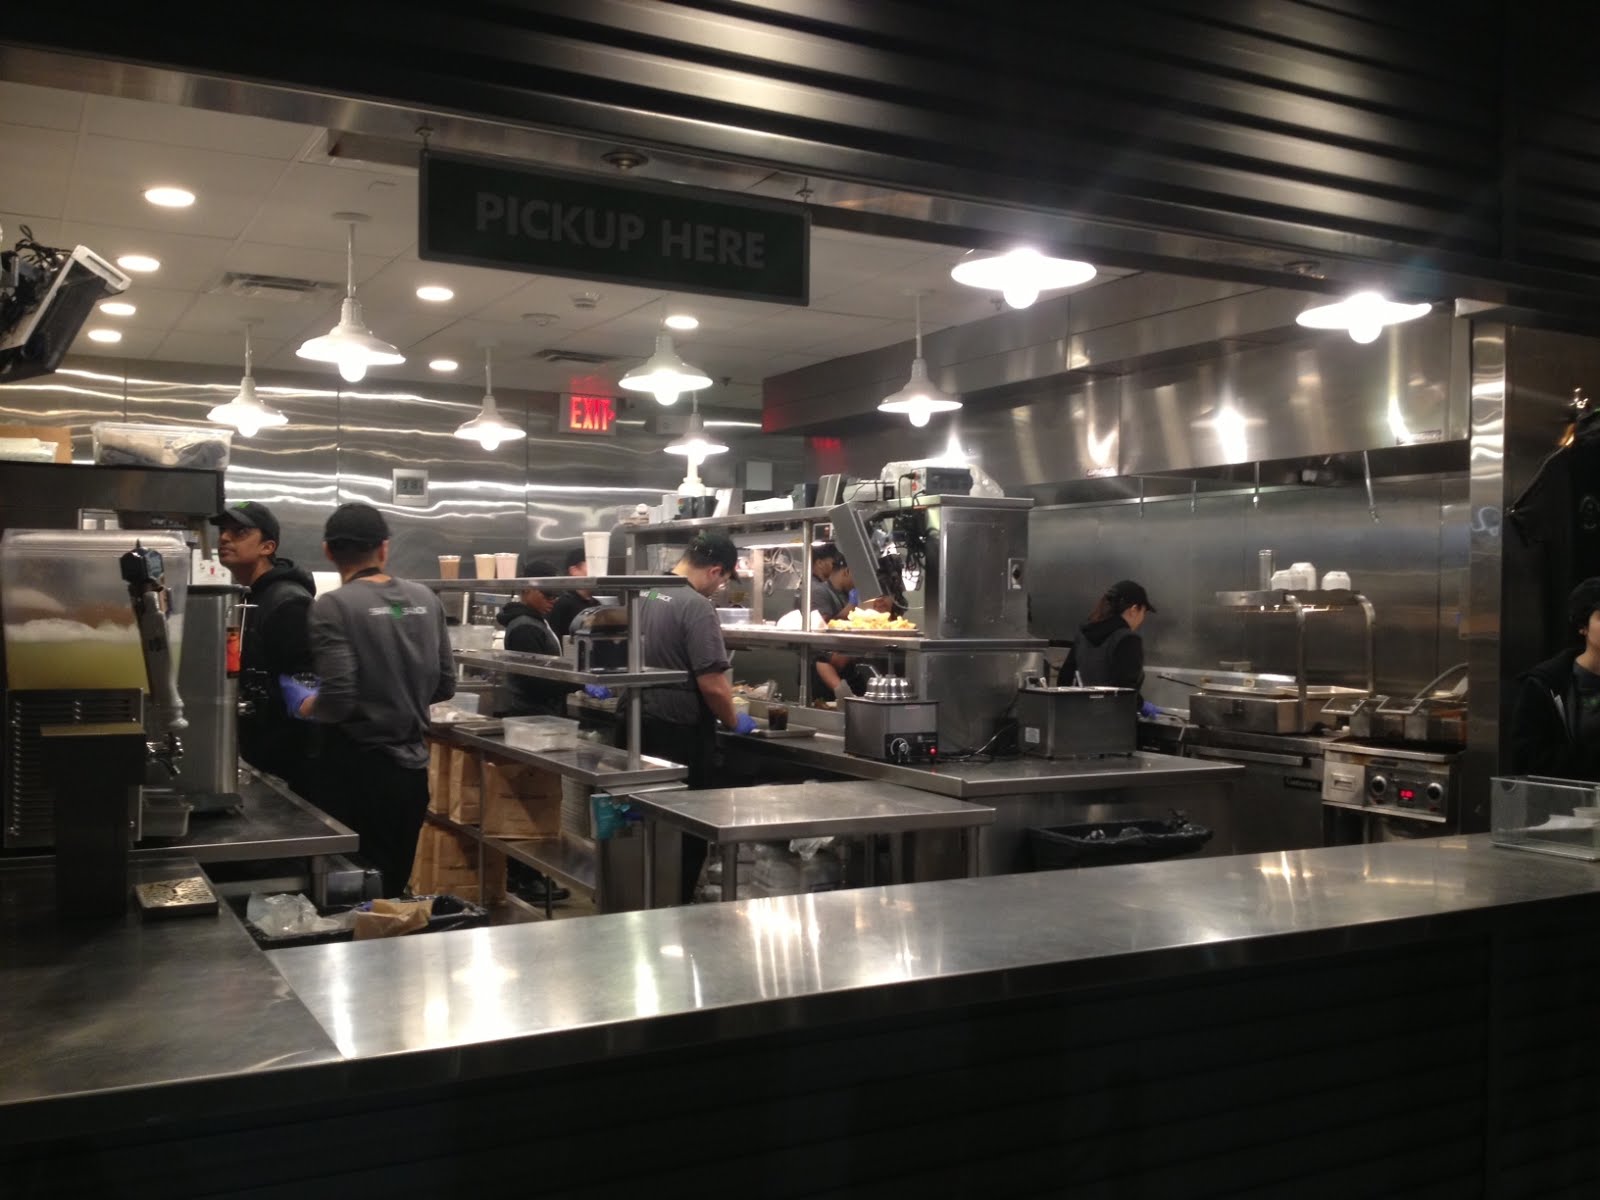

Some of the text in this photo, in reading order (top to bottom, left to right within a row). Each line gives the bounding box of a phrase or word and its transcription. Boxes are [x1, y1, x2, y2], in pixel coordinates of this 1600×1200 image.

[475, 191, 767, 268] PICKUP HERE
[570, 396, 611, 431] EXIT
